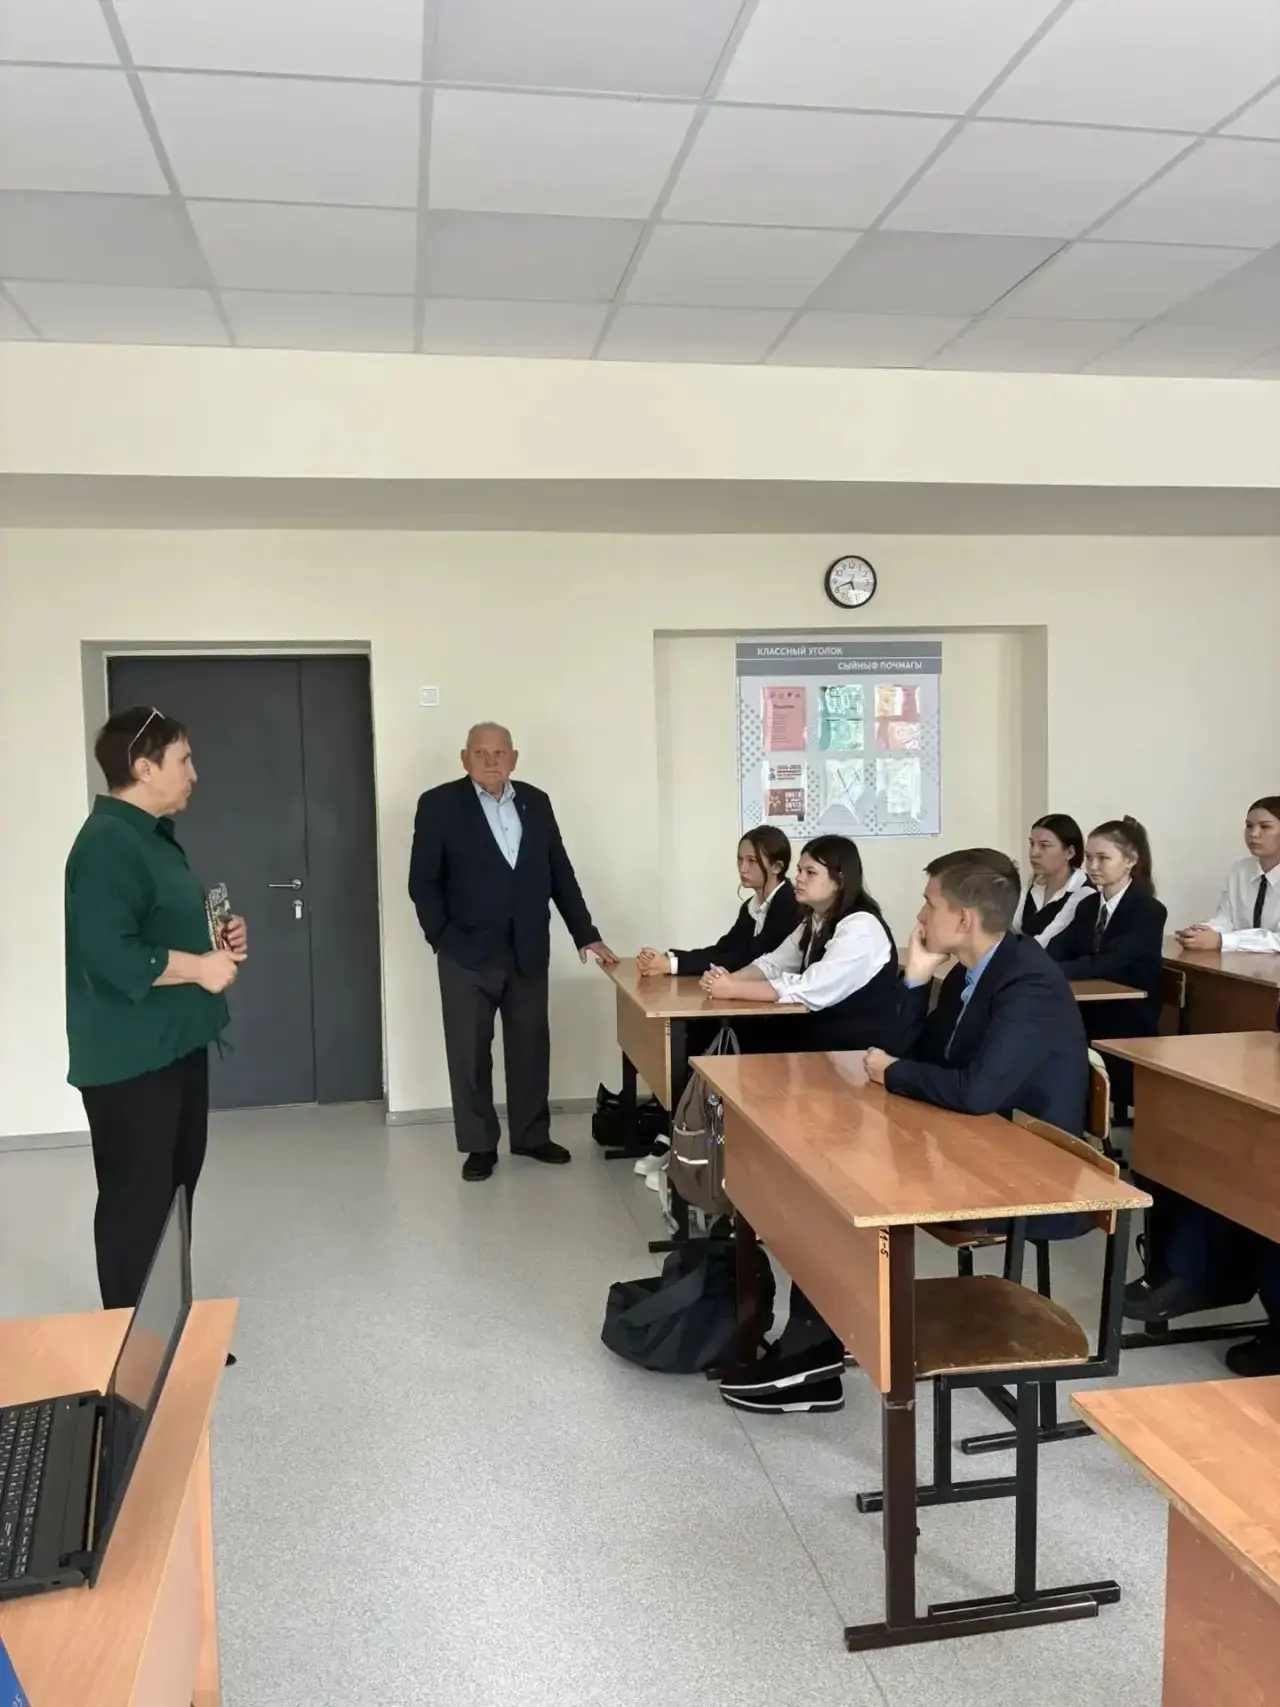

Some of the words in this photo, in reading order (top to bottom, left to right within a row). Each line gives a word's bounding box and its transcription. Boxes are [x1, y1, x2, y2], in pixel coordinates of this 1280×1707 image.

[757, 645, 806, 656] КЛАССНЫЙ
[808, 646, 843, 656] УГОЛОК
[837, 660, 879, 671] СЫЙНЫФ
[880, 660, 922, 670] ПОЧМАГЫ
